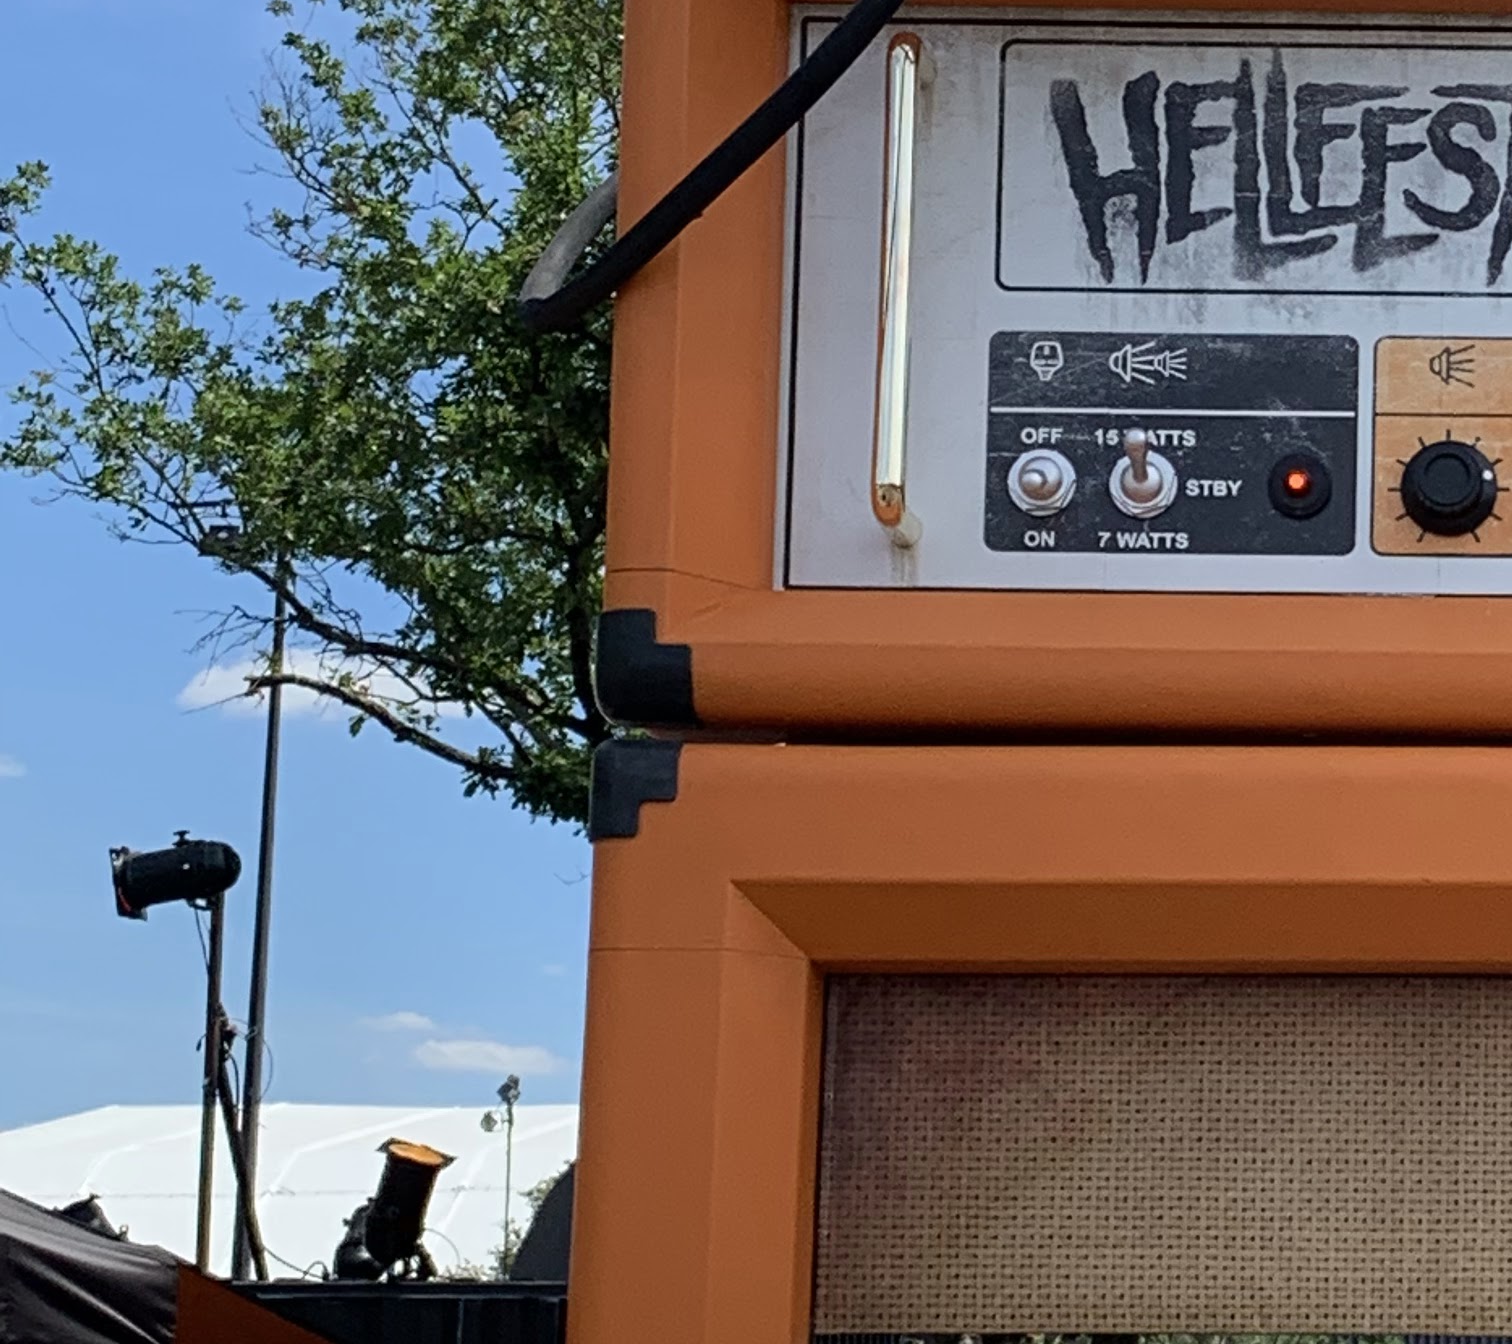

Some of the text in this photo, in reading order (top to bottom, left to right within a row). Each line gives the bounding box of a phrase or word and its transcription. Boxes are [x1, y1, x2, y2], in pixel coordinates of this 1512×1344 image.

[1020, 427, 1063, 445] OFF
[1095, 428, 1197, 447] 15 ATTS
[1184, 479, 1243, 497] STBY
[1023, 531, 1056, 548] ON
[1098, 532, 1190, 549] 7 WATTS
